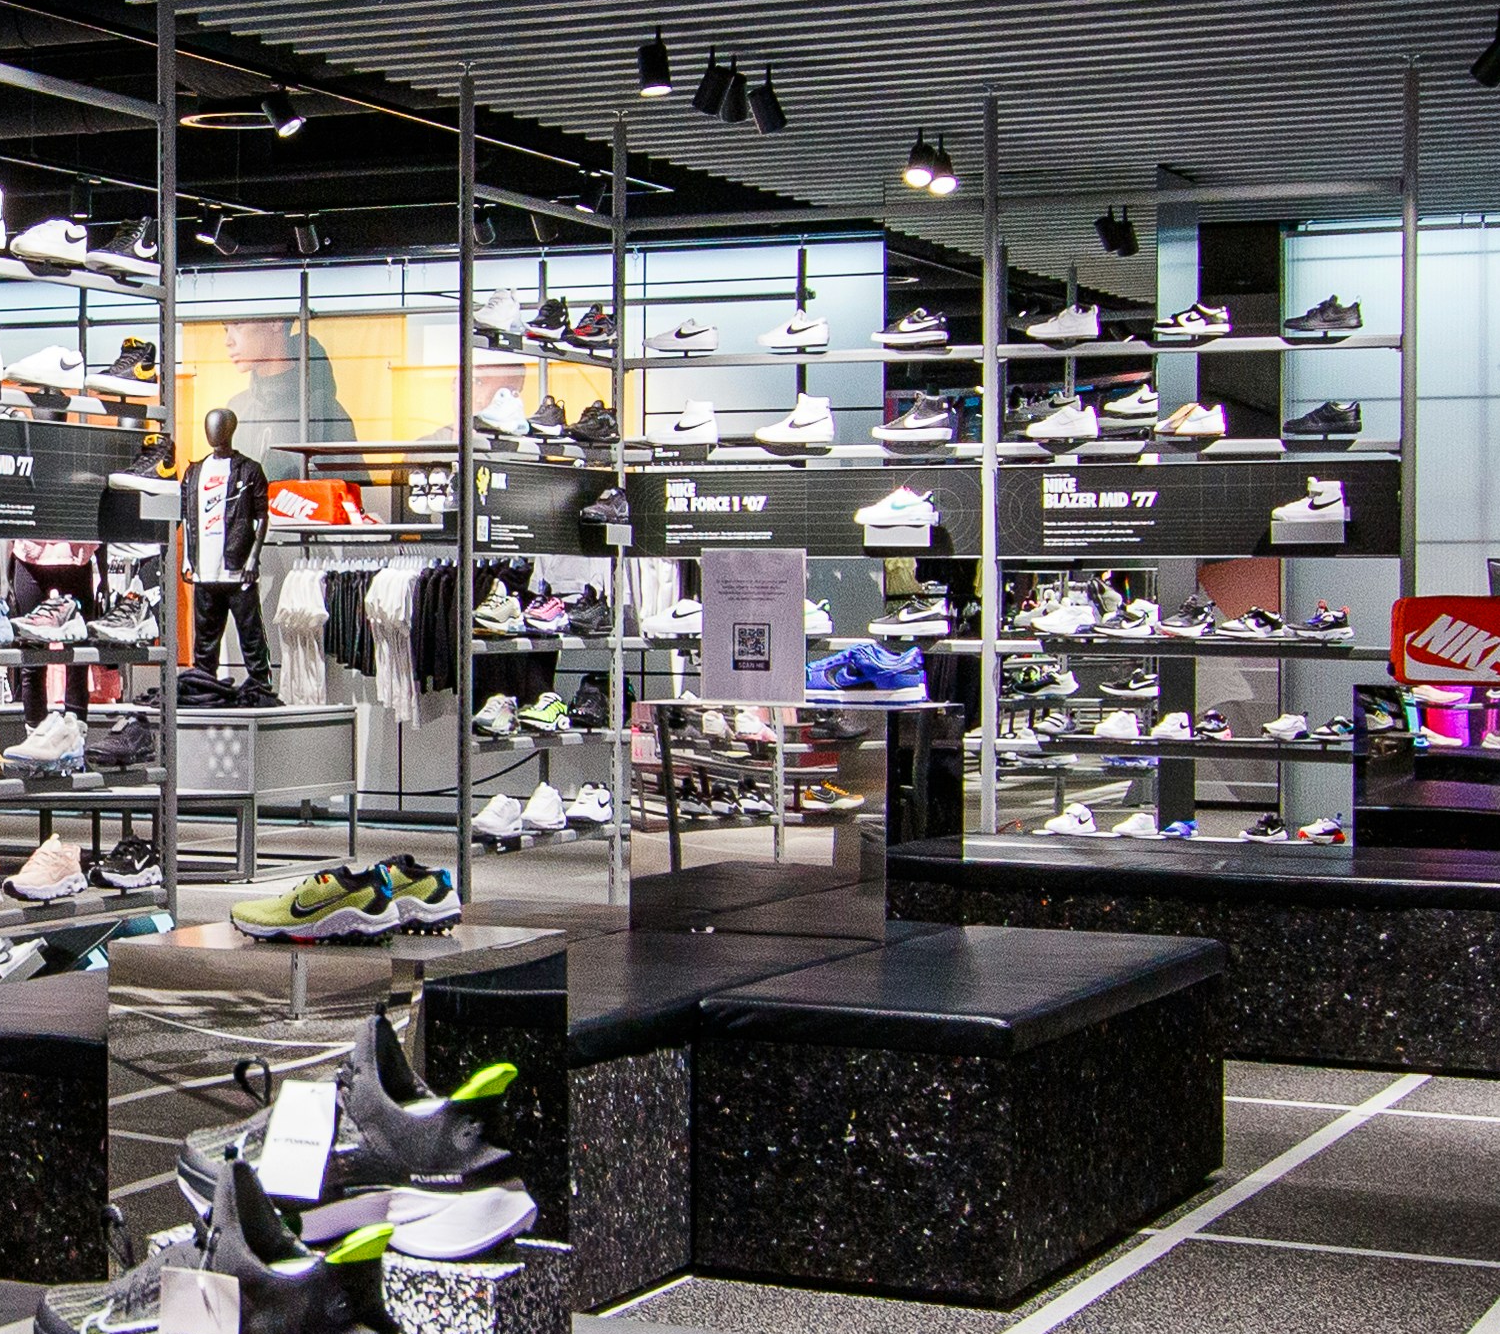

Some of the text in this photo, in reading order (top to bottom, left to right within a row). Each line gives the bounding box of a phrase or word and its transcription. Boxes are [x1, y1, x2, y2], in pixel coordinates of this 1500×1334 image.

[666, 483, 696, 497] NIKE
[1043, 478, 1077, 492] NIKE
[271, 489, 319, 521] NIKE
[666, 497, 689, 512] AIR
[691, 497, 730, 512] FORCE
[732, 497, 740, 511] 1
[1043, 493, 1097, 508] BLAZER
[1099, 492, 1129, 508] MID
